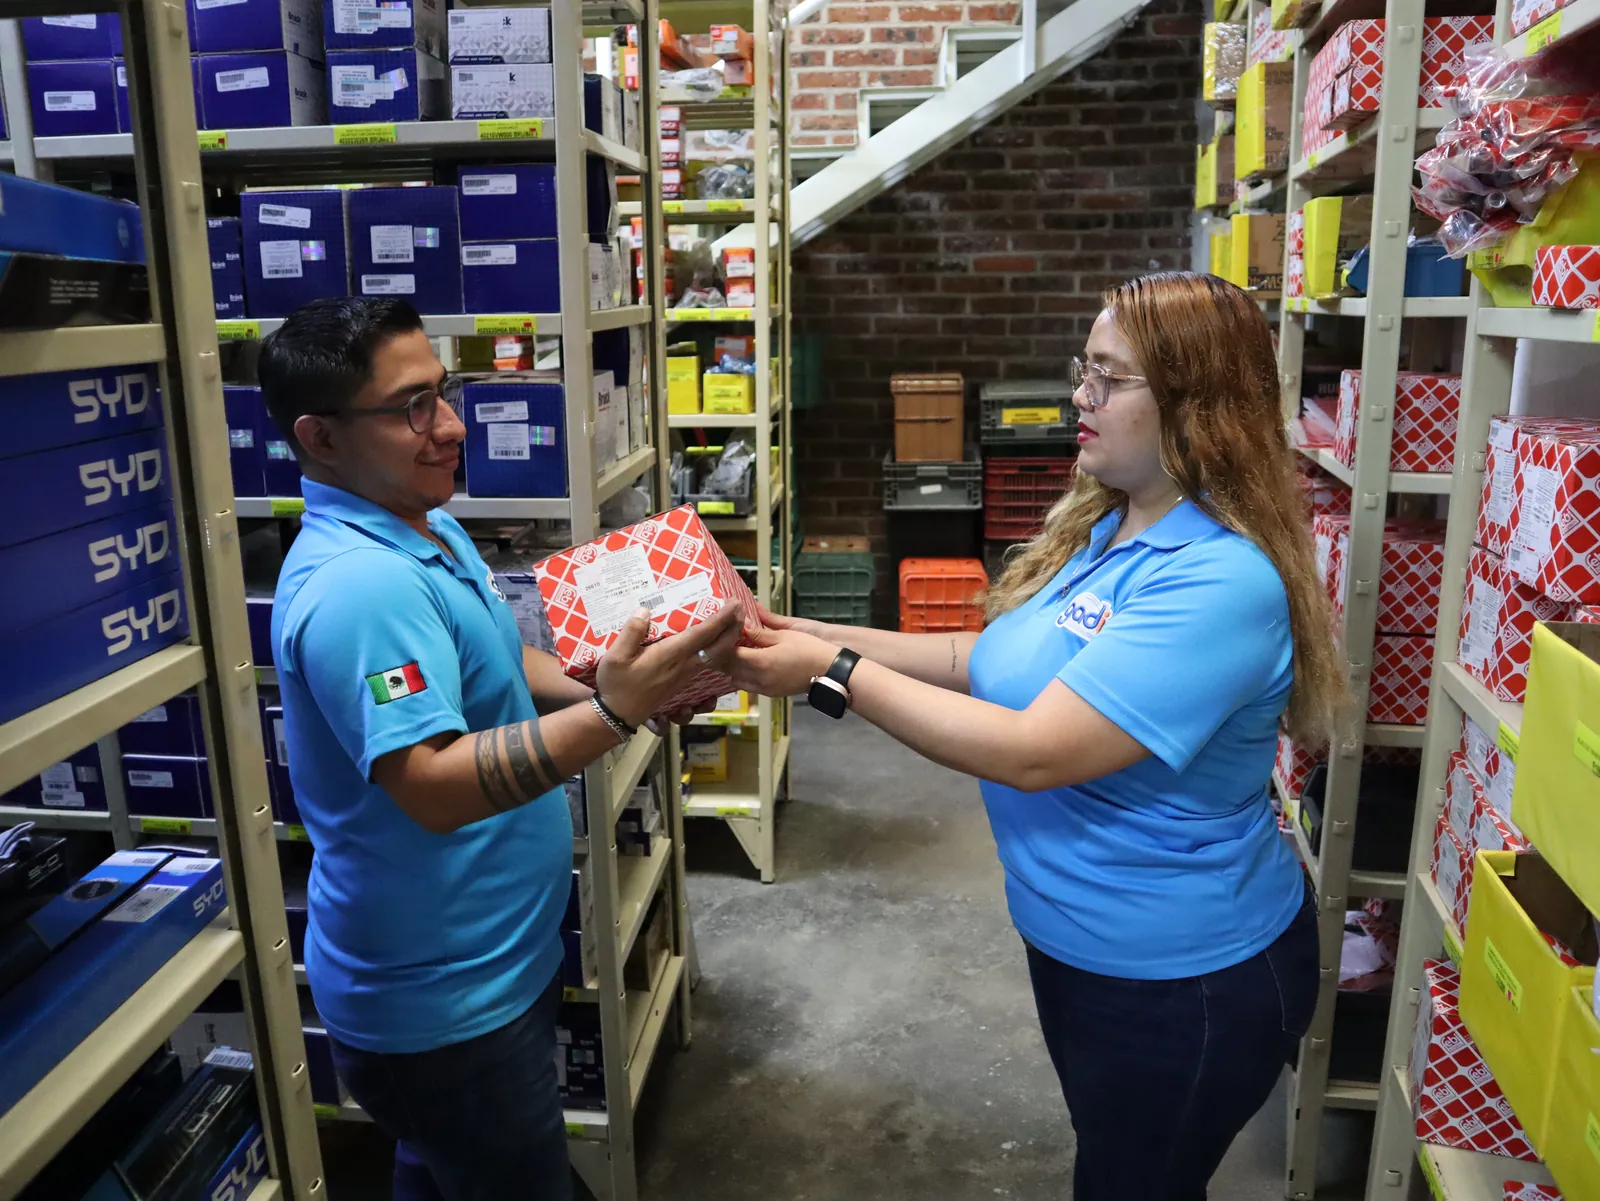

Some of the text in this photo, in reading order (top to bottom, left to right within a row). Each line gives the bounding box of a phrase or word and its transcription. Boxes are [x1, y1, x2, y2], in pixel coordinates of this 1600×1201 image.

[68, 373, 149, 424] SYD
[79, 449, 162, 506] SYD
[88, 521, 169, 583] SYD
[101, 589, 180, 656] SYD
[1057, 602, 1110, 634] gadi
[193, 878, 224, 918] SYD
